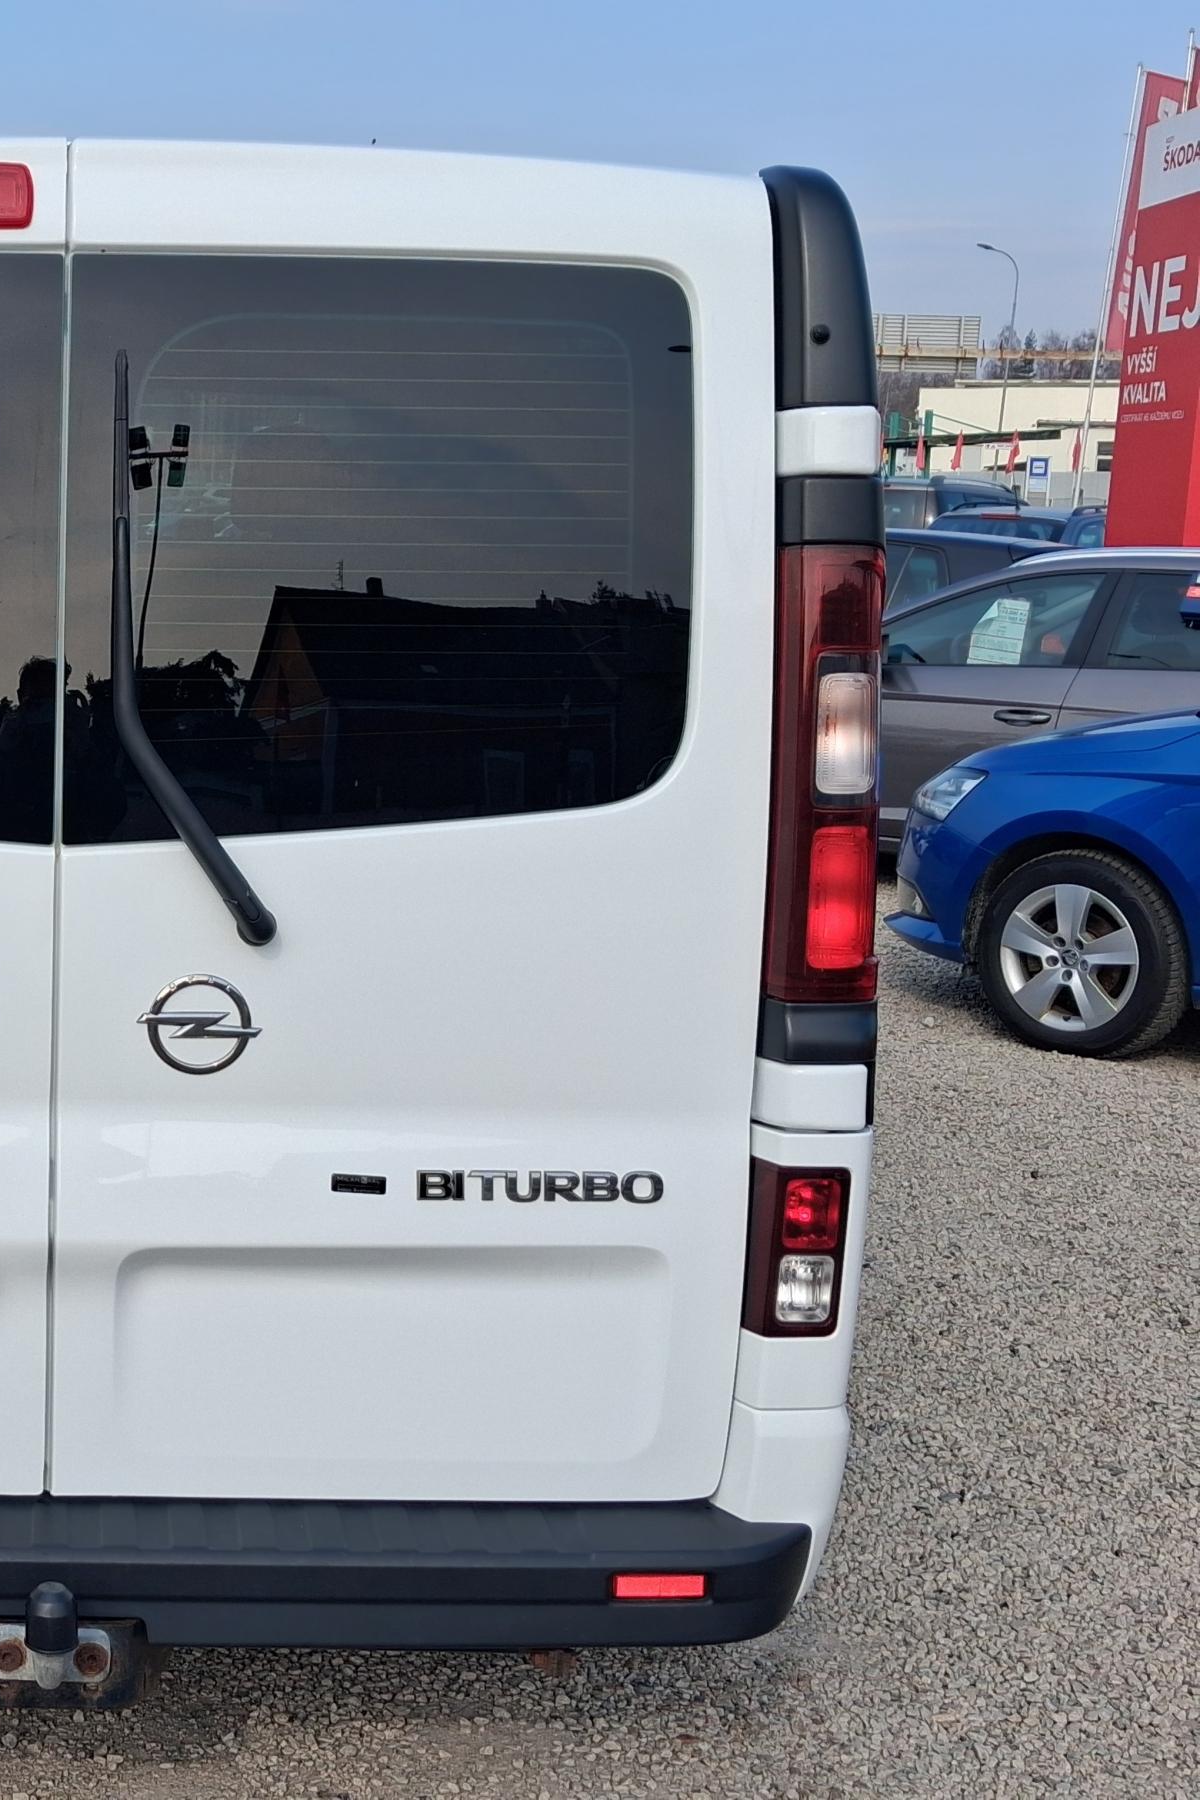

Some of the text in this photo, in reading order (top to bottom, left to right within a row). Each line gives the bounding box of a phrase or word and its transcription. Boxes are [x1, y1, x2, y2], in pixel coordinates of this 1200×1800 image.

[1129, 254, 1200, 338] NEJ
[1127, 346, 1158, 376] VYŠŠÍ
[1122, 380, 1167, 406] KVALITA
